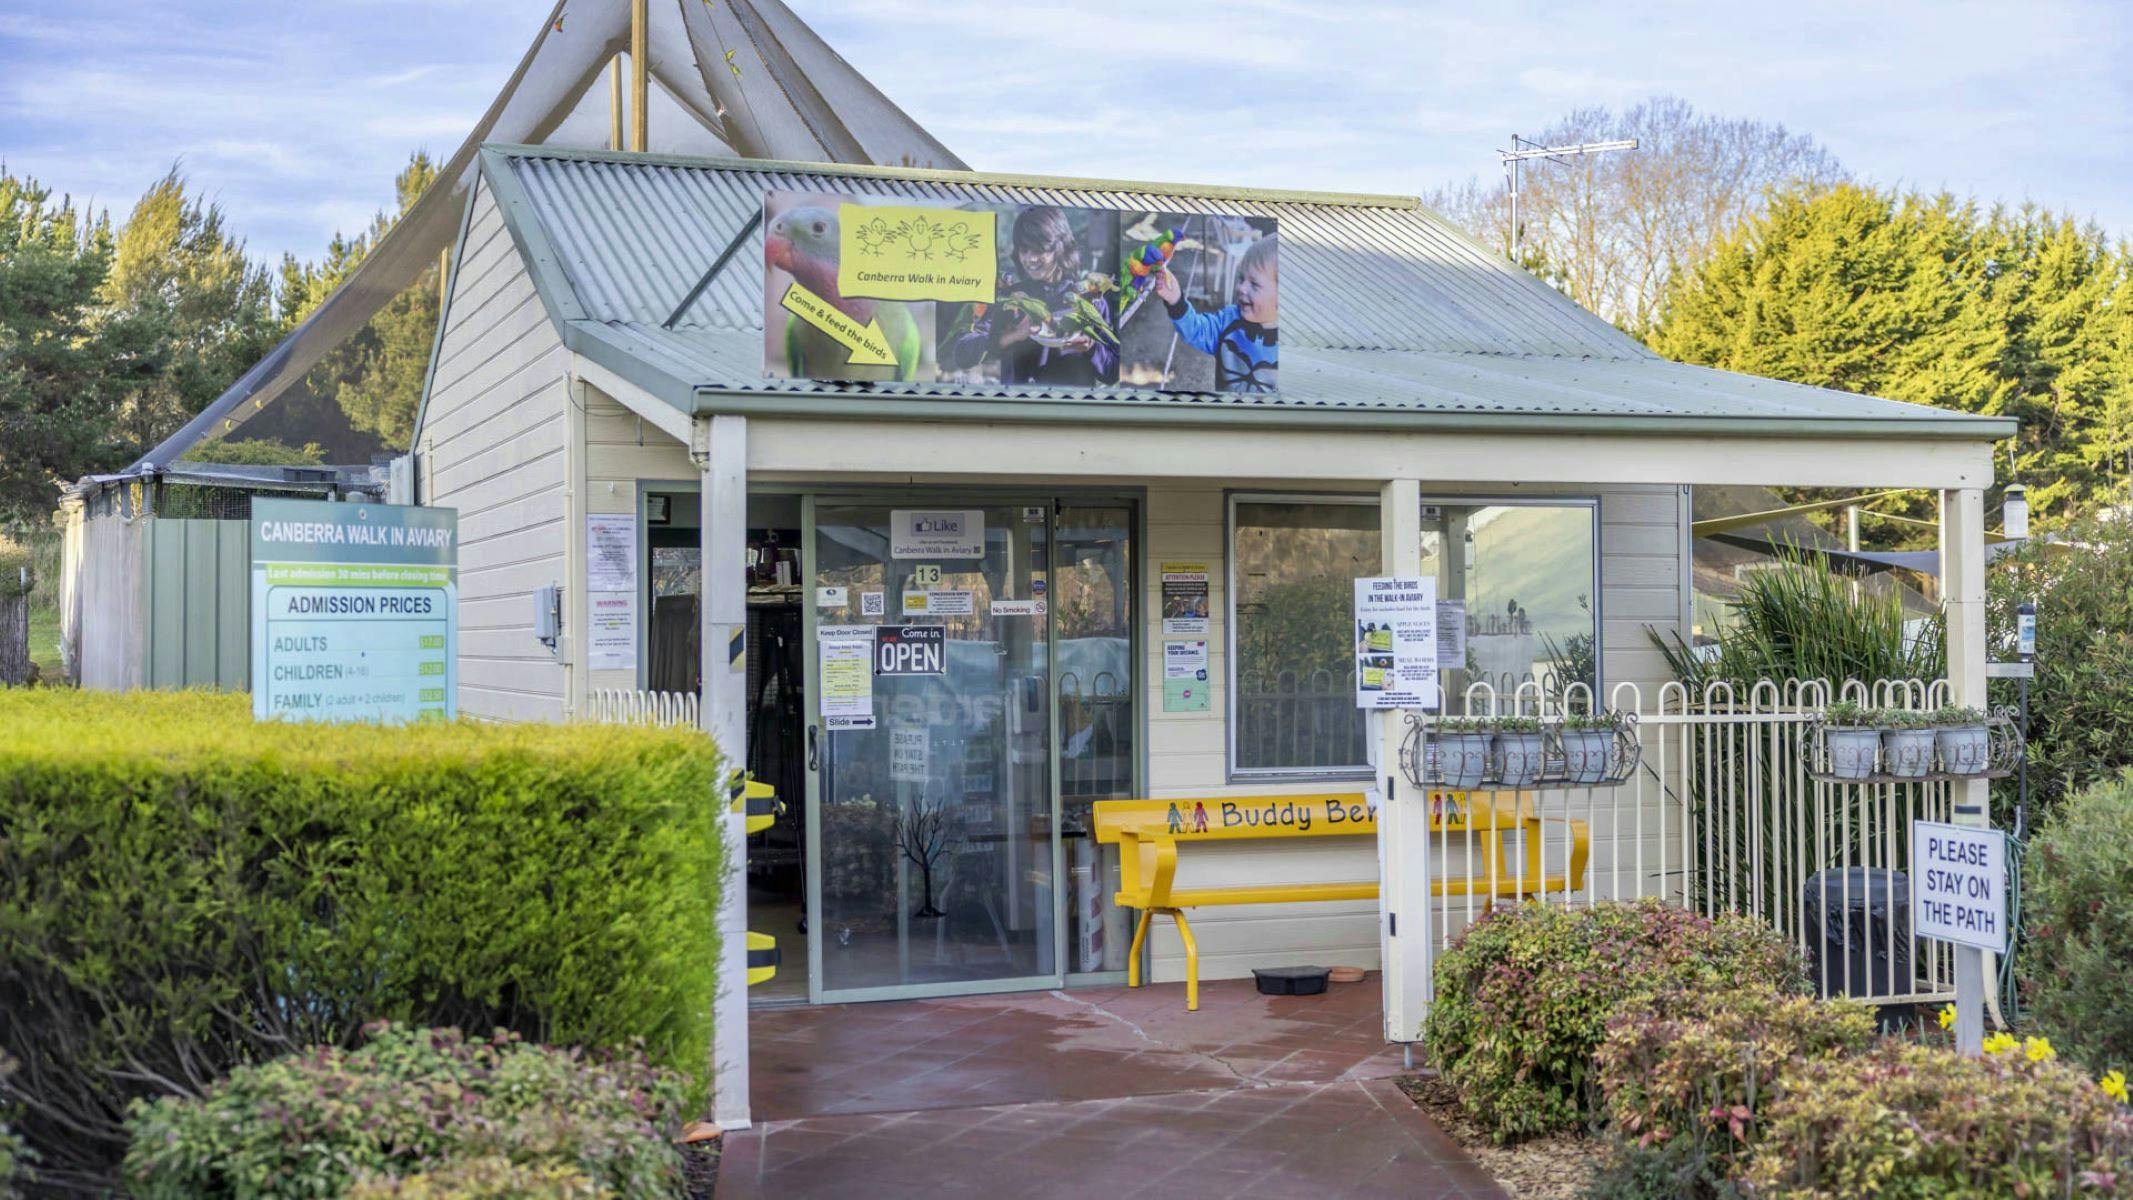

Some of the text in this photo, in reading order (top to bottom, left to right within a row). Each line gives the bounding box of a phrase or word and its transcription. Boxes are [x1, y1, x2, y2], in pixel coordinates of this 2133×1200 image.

[857, 271, 981, 288] Canberra Walk in Aviary
[790, 291, 888, 360] Come & feed the birds
[934, 520, 958, 532] Like
[261, 521, 452, 548] CANBERRA WALK IN AVIARY
[895, 545, 973, 555] Canberra Walk in Aviary
[269, 567, 289, 579] Last
[290, 568, 336, 580] admission
[350, 569, 371, 580] mins
[372, 569, 400, 581] before
[401, 570, 429, 583] closing
[1373, 581, 1418, 591] FEEDING THE BIRDS
[288, 596, 432, 614] ADMISSION PRICES
[596, 600, 628, 608] WARNING
[1368, 594, 1374, 603] IN
[1374, 593, 1384, 602] THE
[1406, 592, 1424, 602] AVIARY
[993, 606, 1031, 615] No Smoking
[820, 628, 836, 637] Keep
[901, 627, 941, 639] Come in
[274, 636, 328, 652] ADULTS
[881, 643, 939, 672] OPEN
[274, 664, 343, 681] CHILDREN
[274, 693, 323, 710] FAMILY
[829, 718, 850, 726] Slide
[1221, 802, 1311, 831] Buddy
[1929, 837, 1988, 867] PLEASE
[1927, 869, 1990, 901] STAY ON
[1923, 899, 1996, 934] THE PATH
